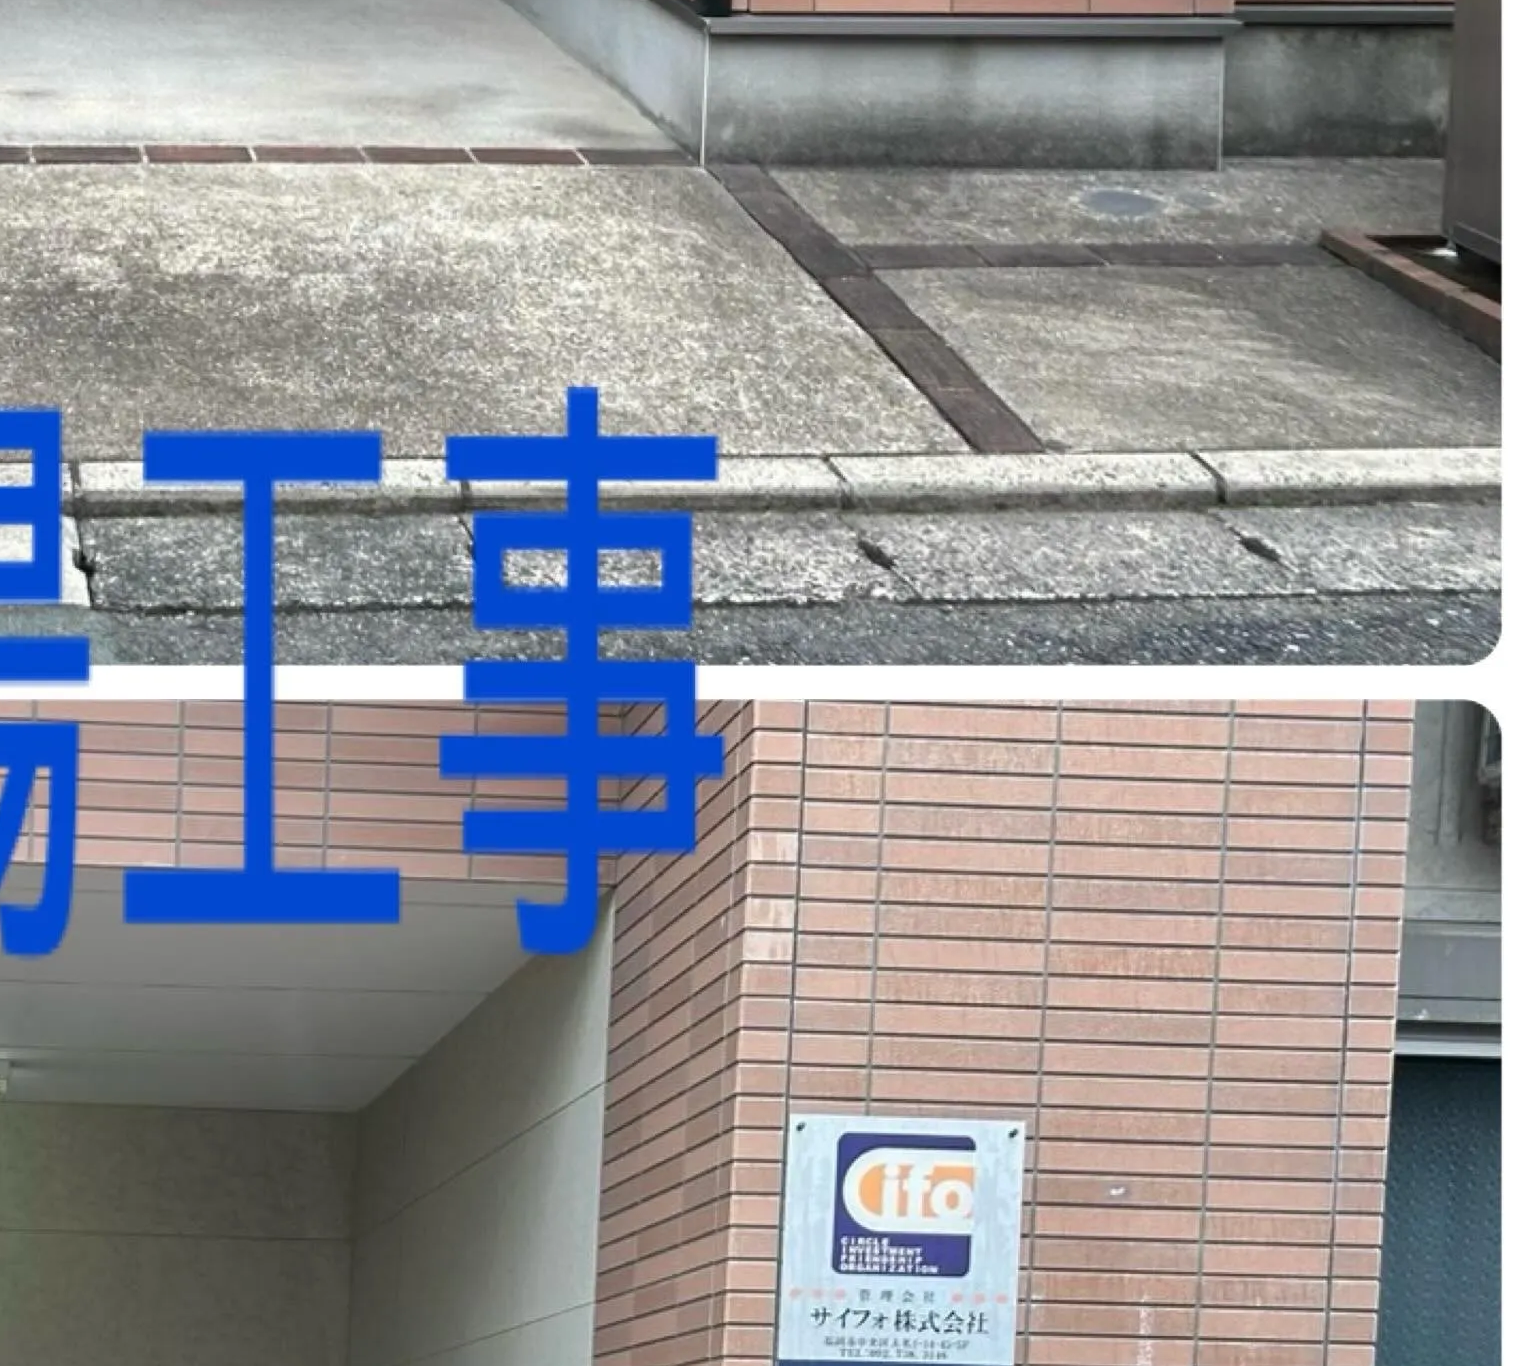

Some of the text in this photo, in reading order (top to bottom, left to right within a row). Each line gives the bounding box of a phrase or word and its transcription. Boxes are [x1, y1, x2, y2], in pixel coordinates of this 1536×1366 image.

[810, 1306, 989, 1335] サイフォ株式会社
